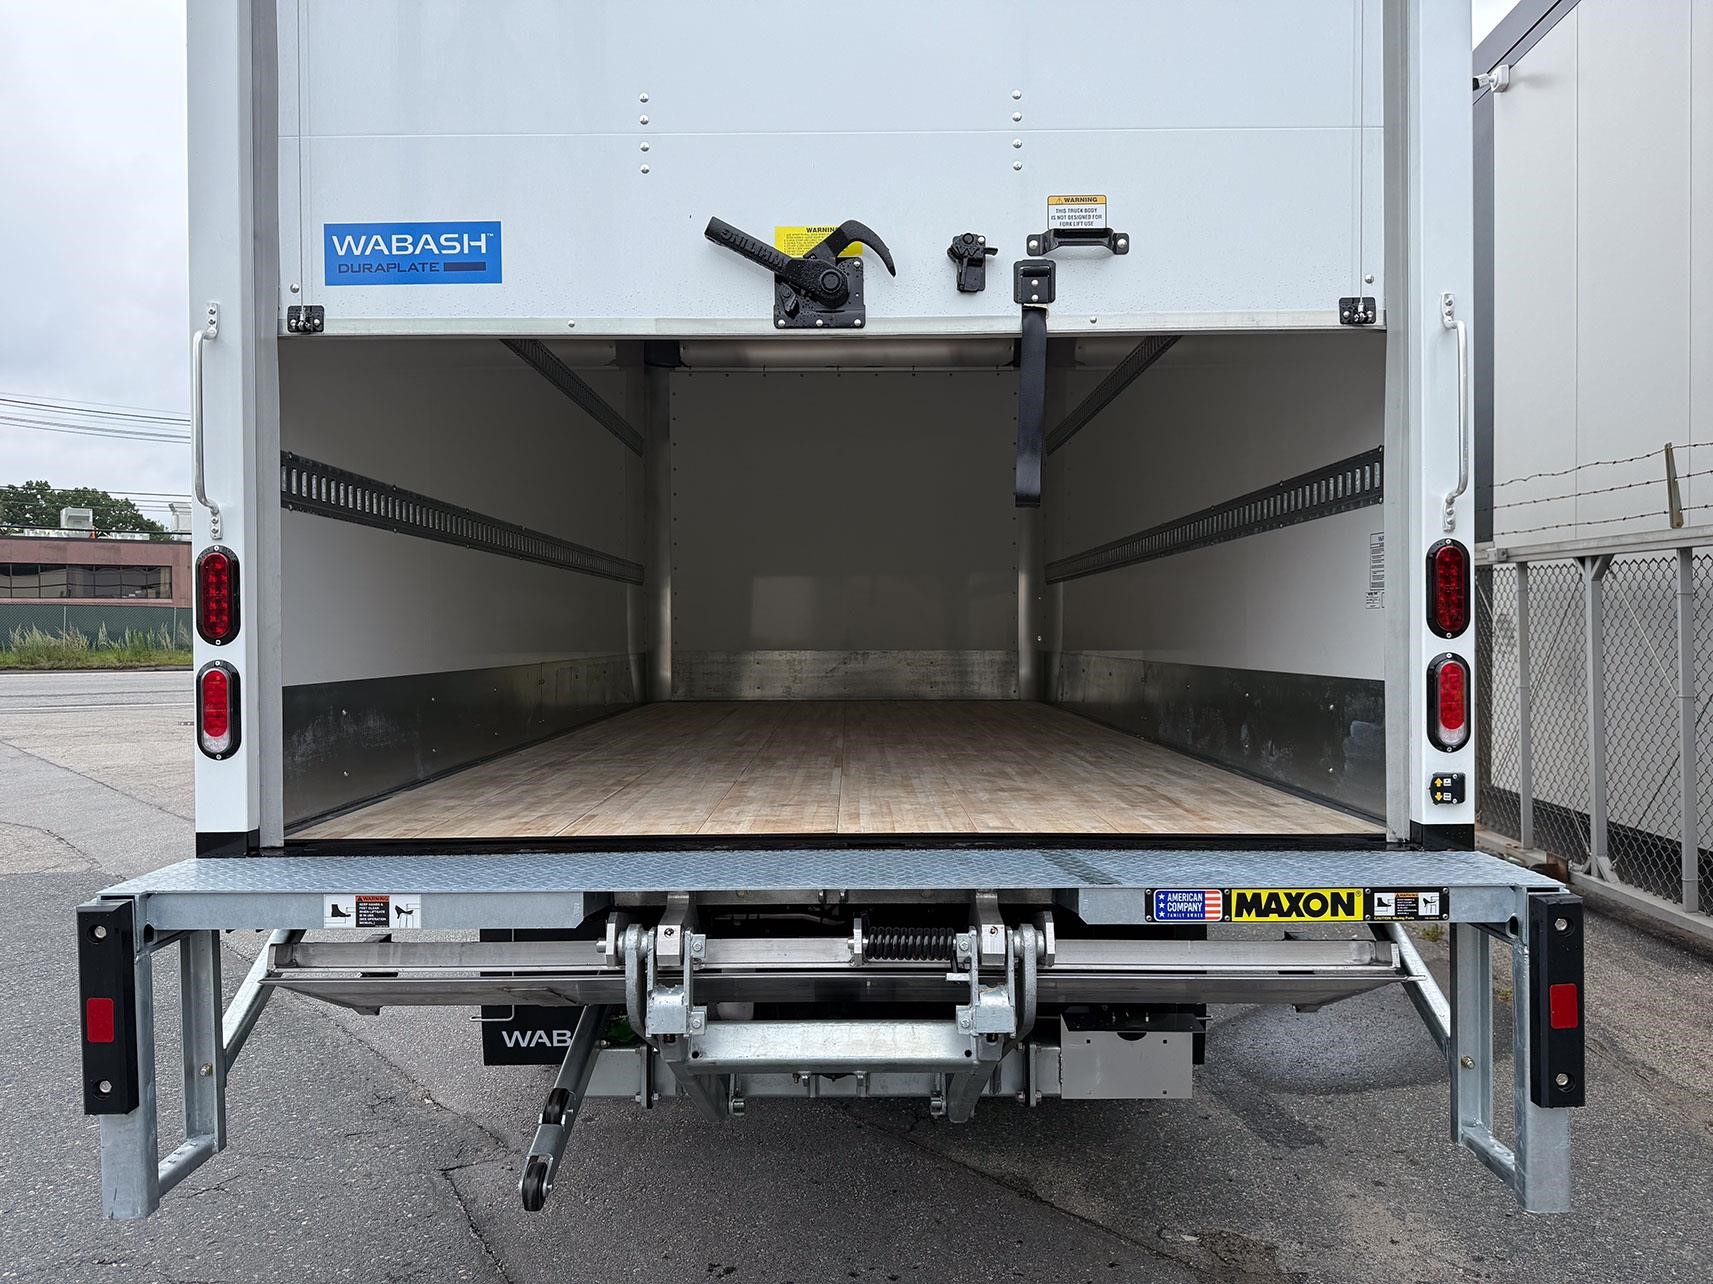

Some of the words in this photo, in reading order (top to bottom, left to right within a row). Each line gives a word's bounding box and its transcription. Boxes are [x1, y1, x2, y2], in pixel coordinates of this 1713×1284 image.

[332, 233, 487, 256] WABASH
[338, 262, 440, 274] DURAPLATE
[1167, 892, 1203, 901] AMERICAN
[1167, 902, 1203, 912] COMPANY
[1235, 892, 1355, 918] MAXON
[502, 1030, 573, 1048] WAB
